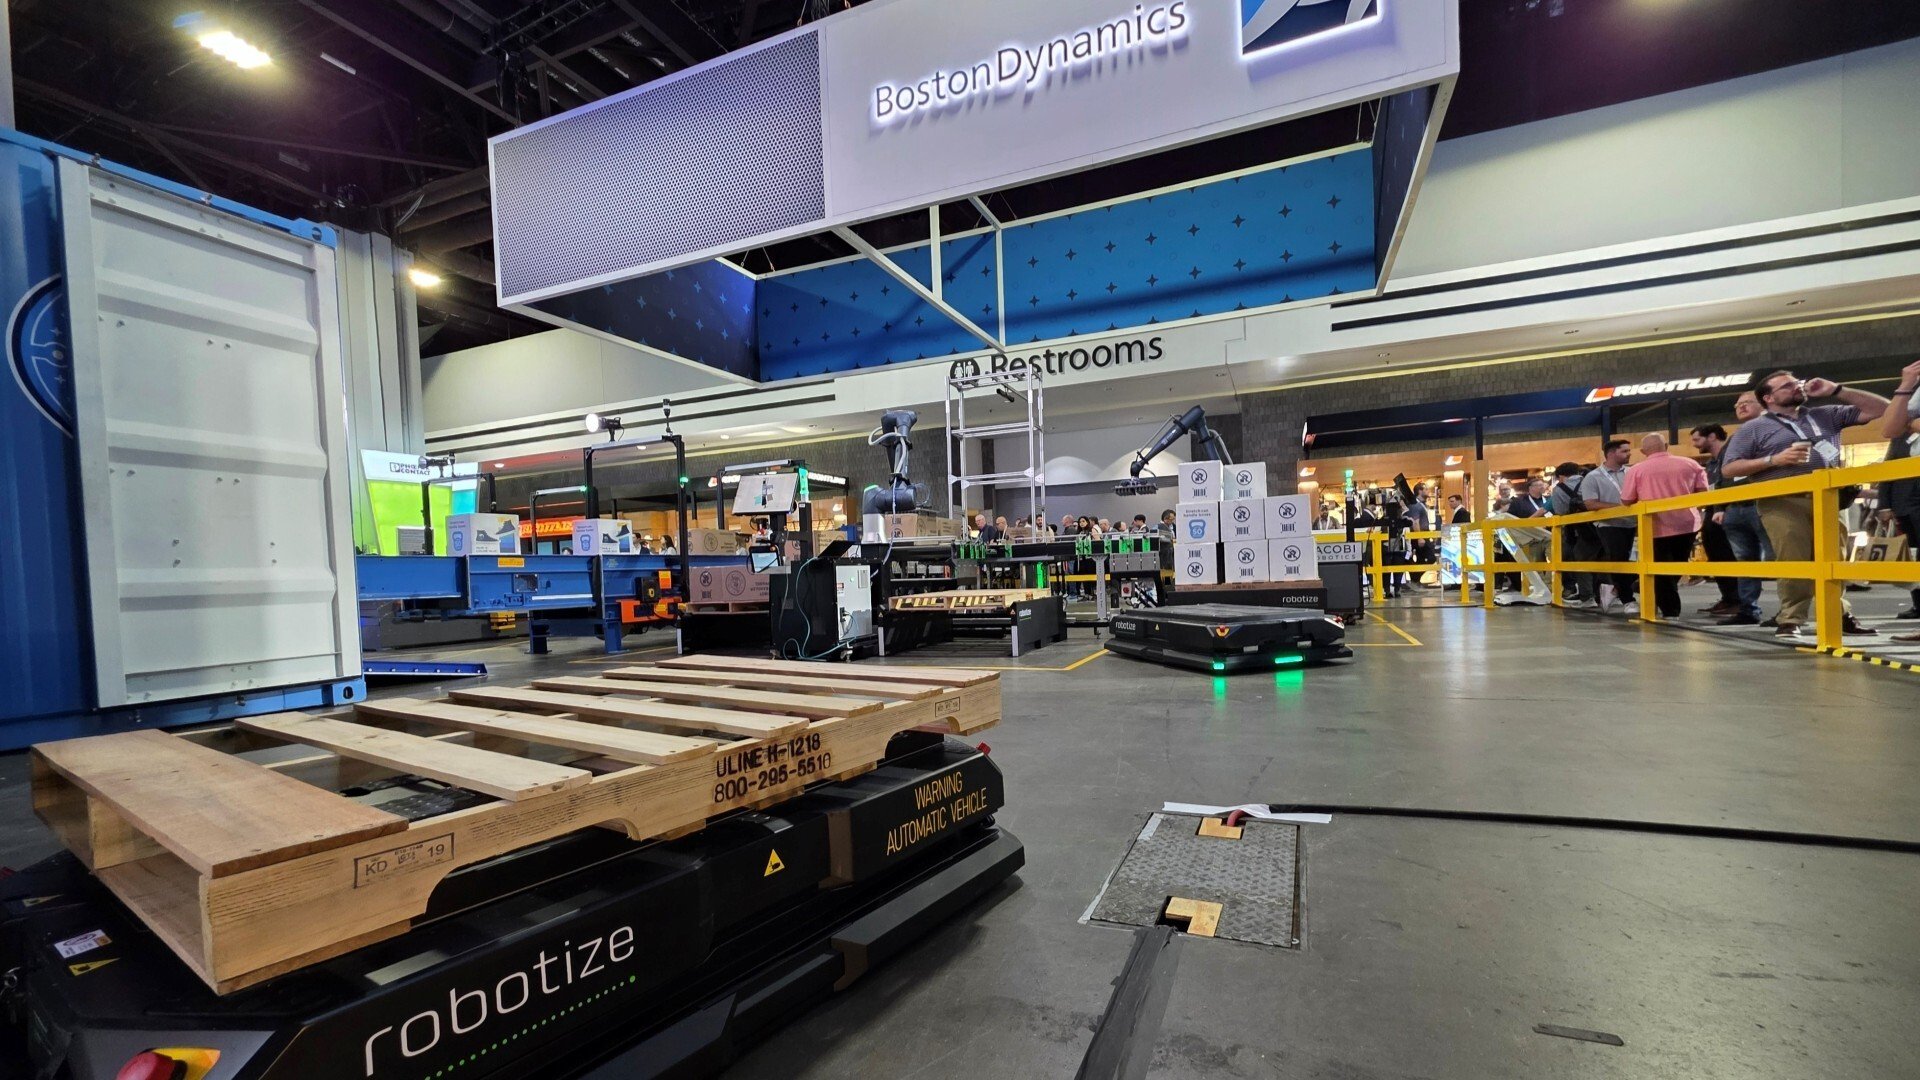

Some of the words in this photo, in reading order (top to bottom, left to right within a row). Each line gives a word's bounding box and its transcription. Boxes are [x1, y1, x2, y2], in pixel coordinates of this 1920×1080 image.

[1611, 373, 1753, 397] RIGHTLINE
[1317, 544, 1356, 554] ACOBI
[1282, 595, 1319, 603] robotize
[1115, 621, 1136, 631] robotize
[716, 747, 763, 778] ULINE
[767, 733, 821, 764] H-1218
[714, 752, 831, 803] 800-295-5510
[914, 771, 963, 811] WARNING
[886, 806, 947, 856] AUTOMATIC
[950, 787, 988, 823] VEHICLE
[365, 860, 388, 876] KD
[427, 843, 445, 858] 19
[365, 925, 634, 1077] robotize
